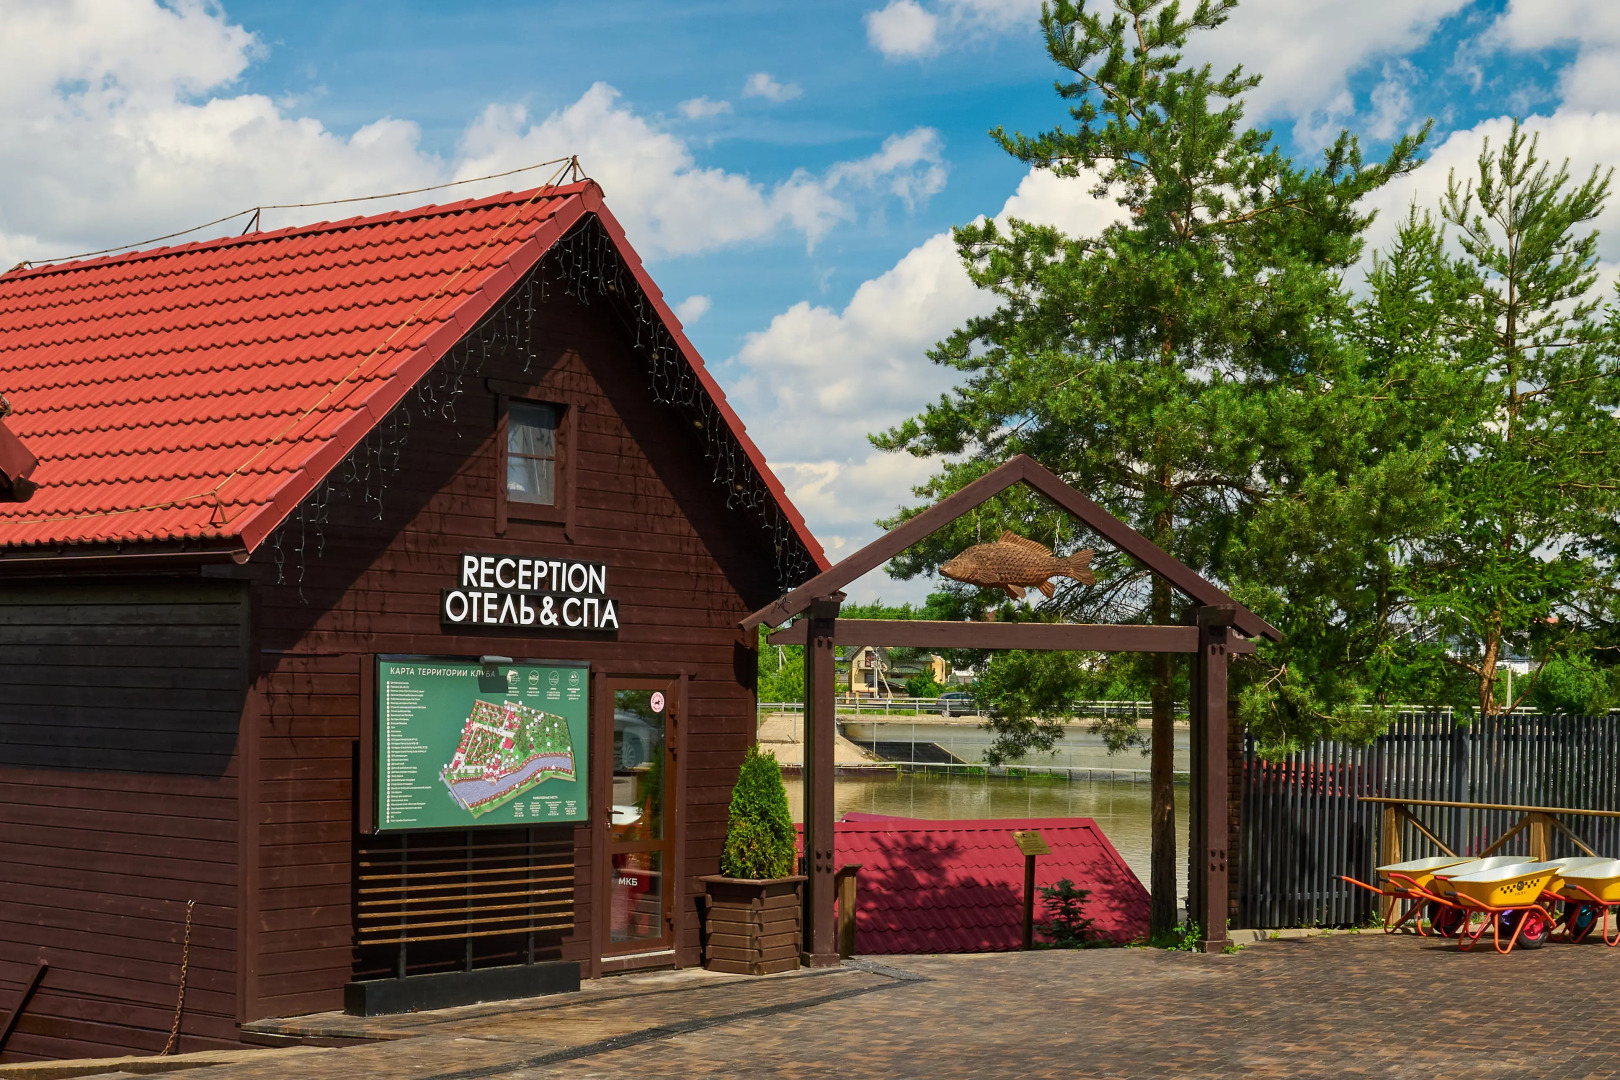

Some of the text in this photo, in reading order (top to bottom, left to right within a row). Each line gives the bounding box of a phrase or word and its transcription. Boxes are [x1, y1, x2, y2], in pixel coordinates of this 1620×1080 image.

[462, 555, 606, 594] RECEPTION
[445, 590, 619, 629] ОТЕЛЬ & СПА
[390, 667, 496, 678] КАРТА ТЕРРИТОРИИ КЛУБА
[618, 876, 638, 887] МКБ
